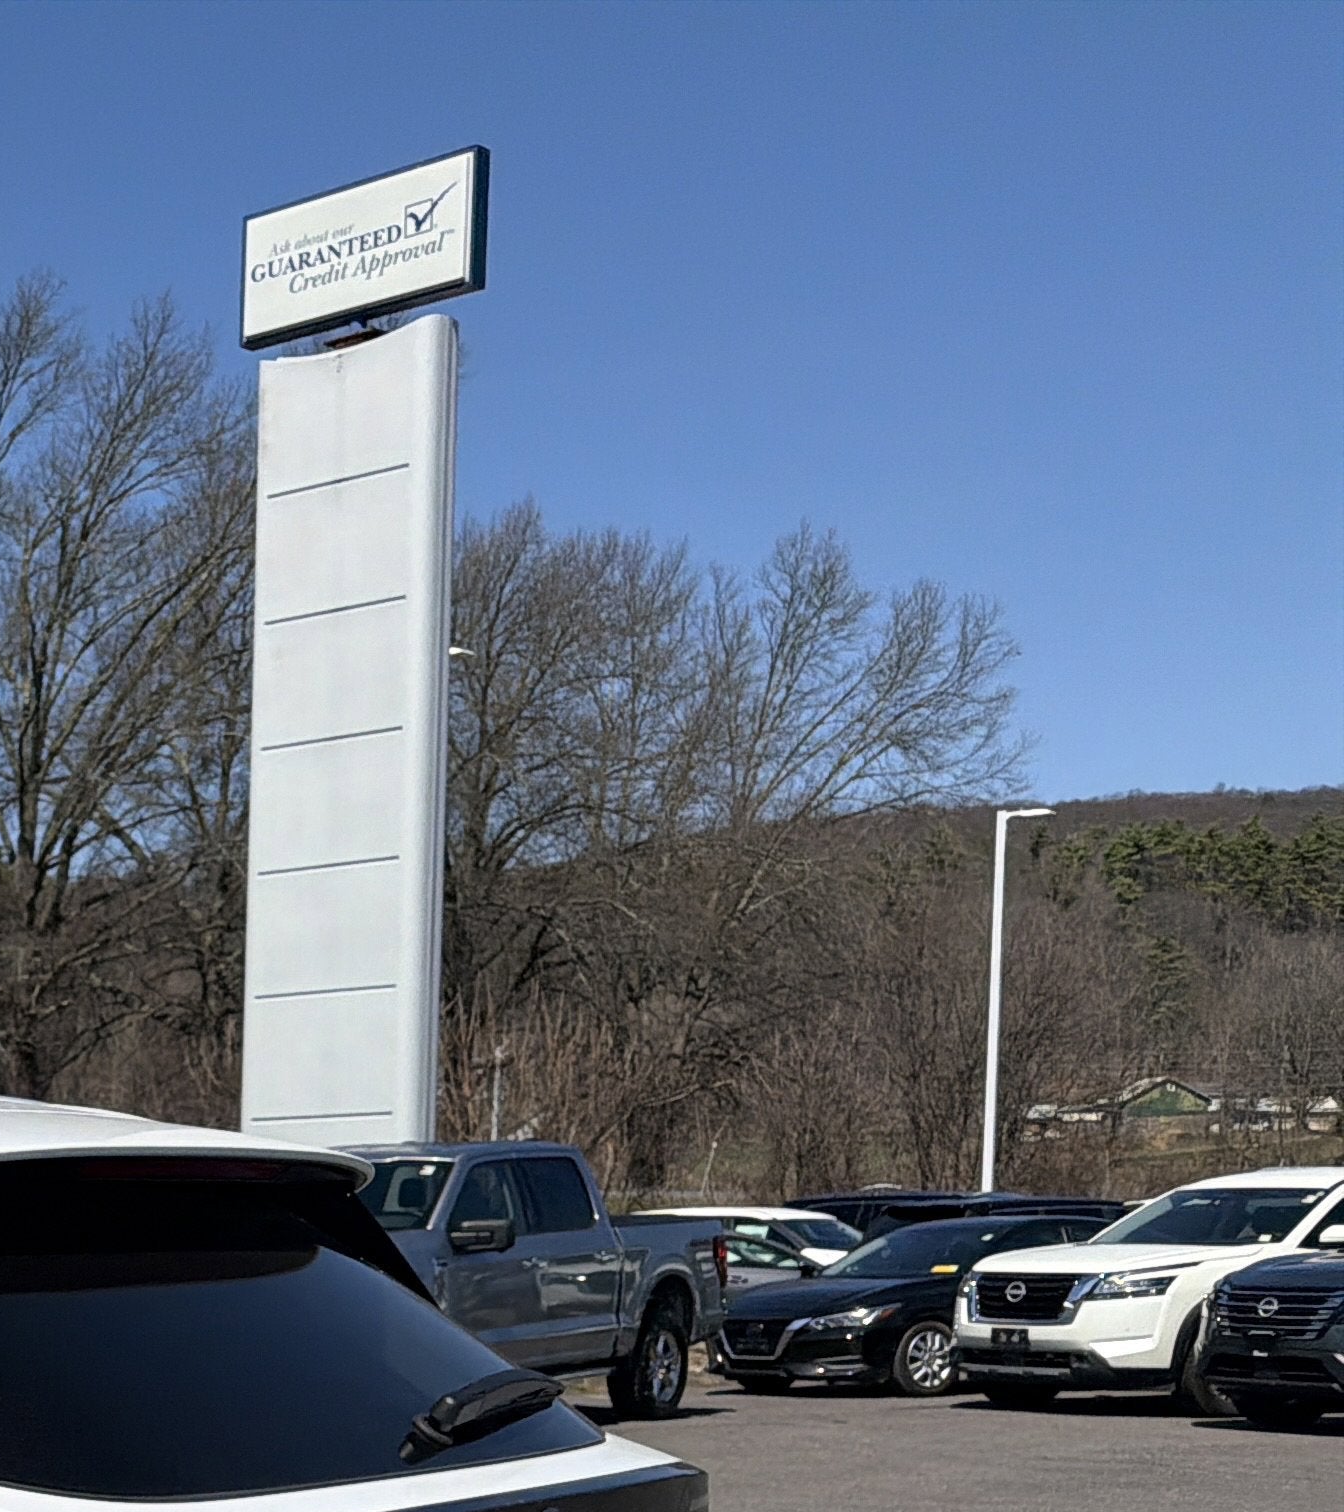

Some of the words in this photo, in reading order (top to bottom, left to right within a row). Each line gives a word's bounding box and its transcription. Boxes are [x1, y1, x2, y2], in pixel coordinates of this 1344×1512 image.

[250, 224, 402, 283] GUARANTEED
[269, 239, 291, 256] Ask
[294, 230, 329, 249] about
[332, 224, 355, 241] our
[289, 262, 349, 294] Credit
